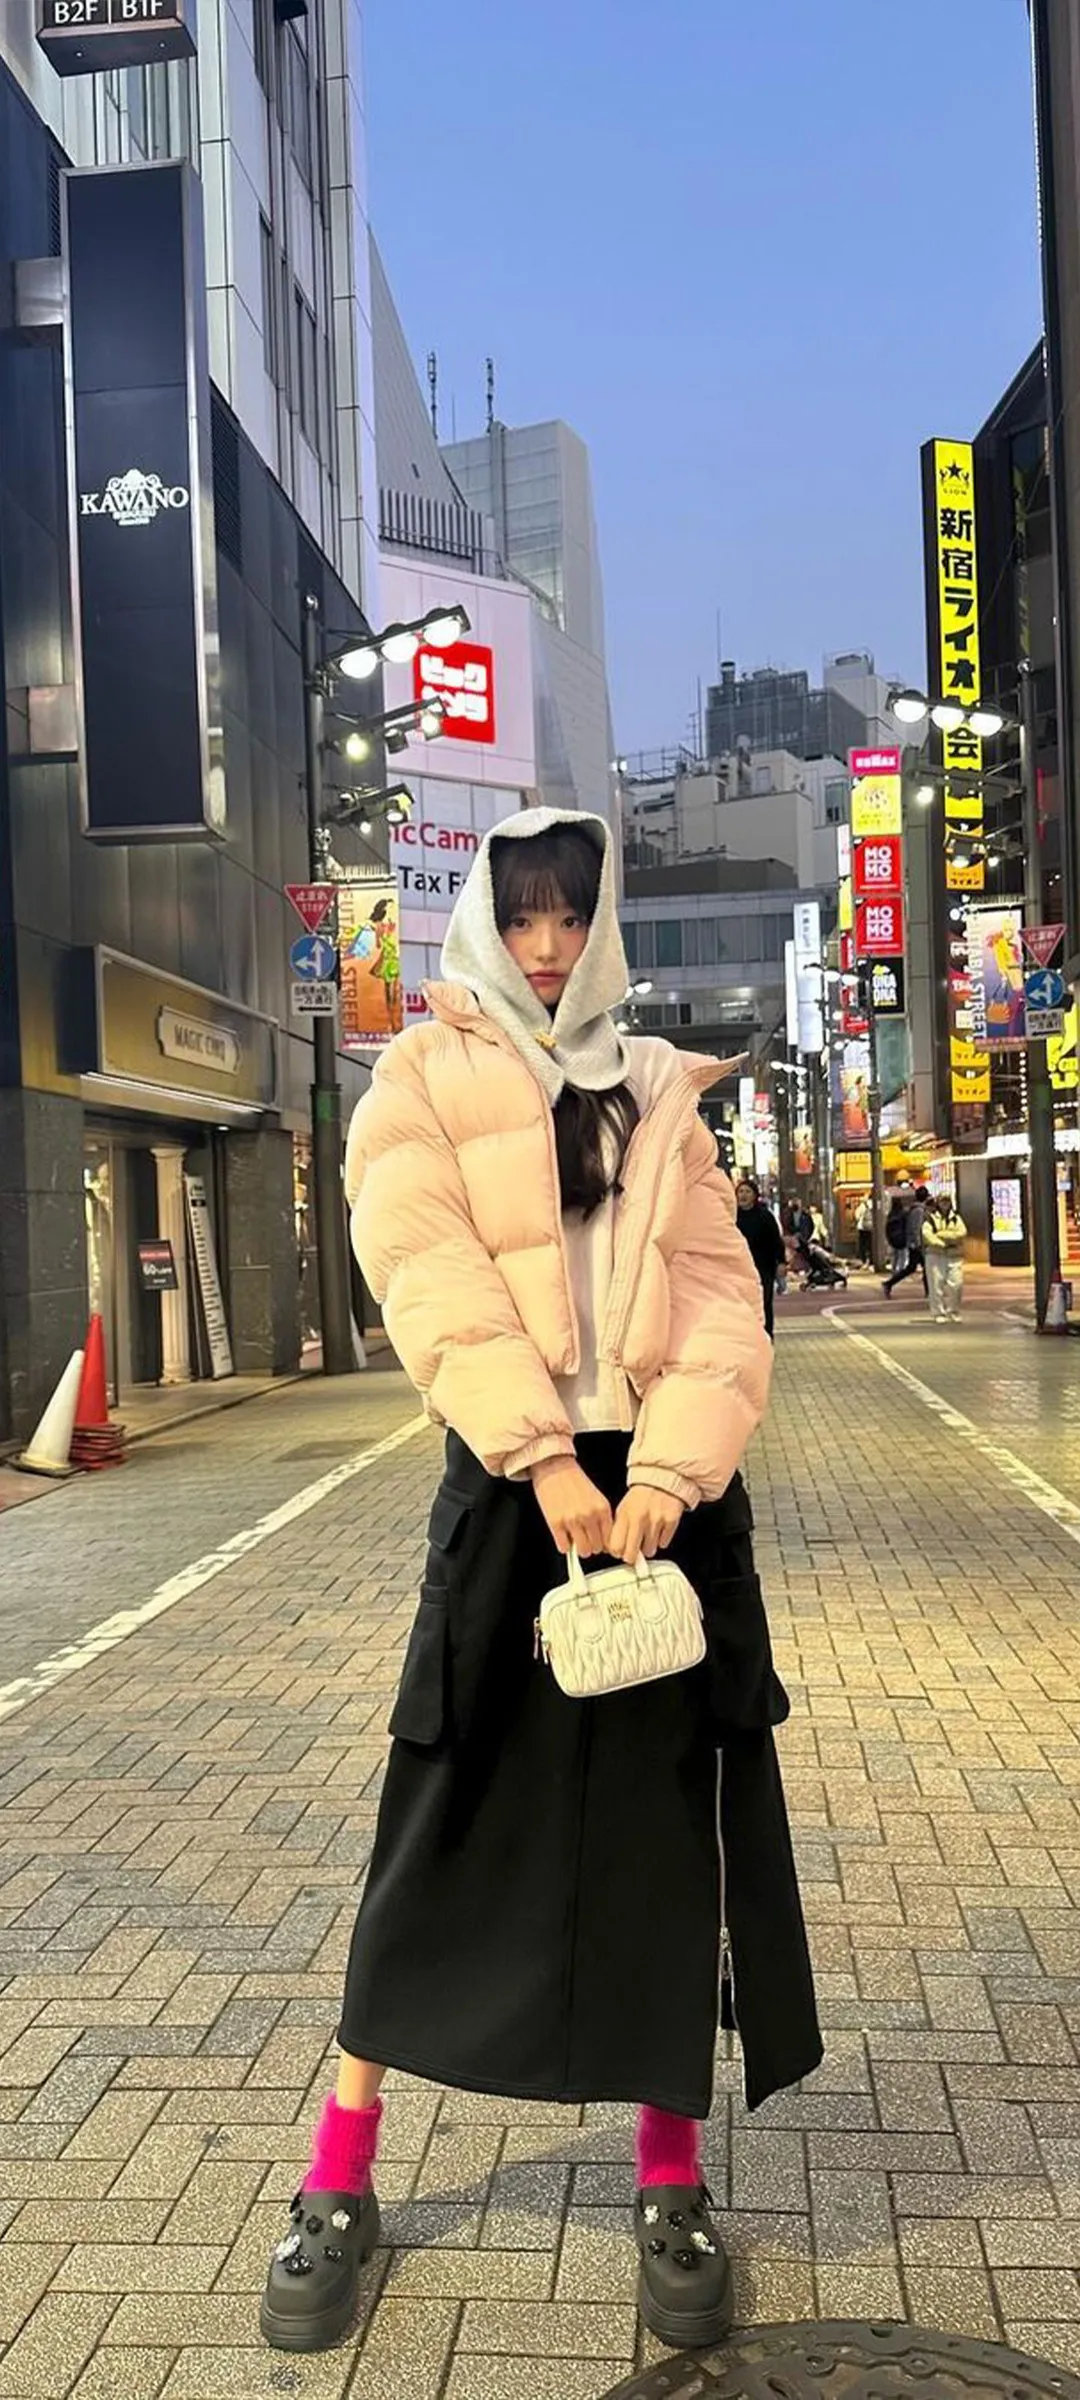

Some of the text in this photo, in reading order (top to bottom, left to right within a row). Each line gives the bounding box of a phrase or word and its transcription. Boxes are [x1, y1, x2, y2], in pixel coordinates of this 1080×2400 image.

[54, 0, 164, 24] B2F B1F
[80, 486, 190, 515] KAWANO
[398, 865, 467, 895] Tax F
[341, 966, 359, 1032] STREET
[971, 982, 987, 1039] STREET
